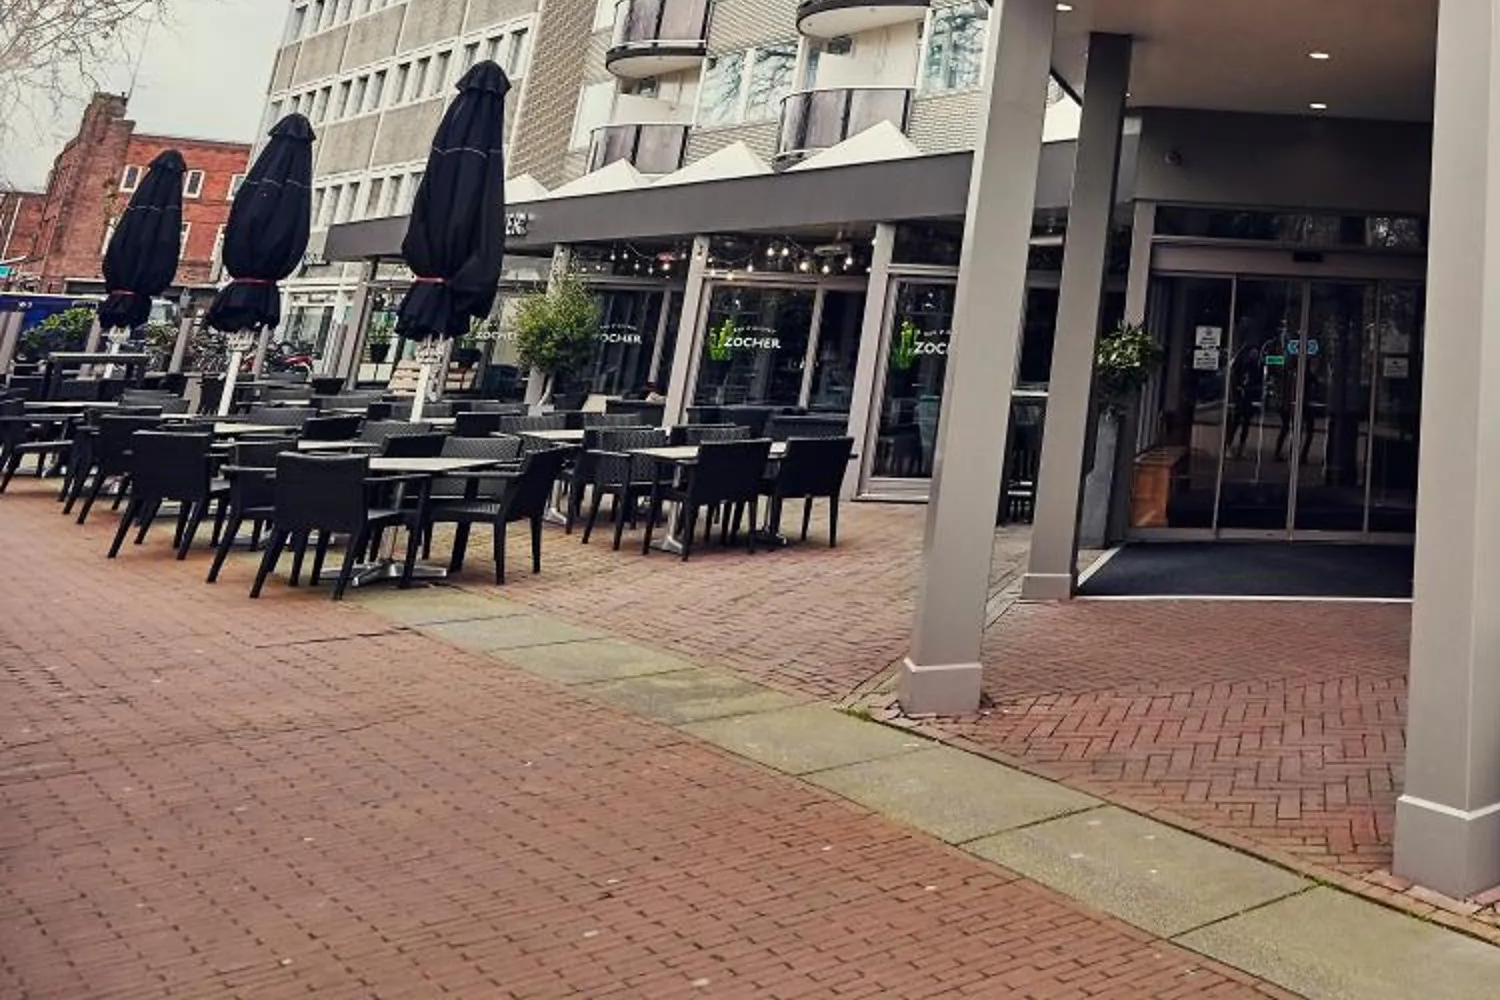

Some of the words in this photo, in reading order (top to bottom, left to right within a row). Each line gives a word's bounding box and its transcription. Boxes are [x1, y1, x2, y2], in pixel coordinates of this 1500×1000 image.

[599, 333, 642, 345] OCHER
[723, 337, 781, 349] ZOCHER
[914, 341, 948, 355] ZOC
